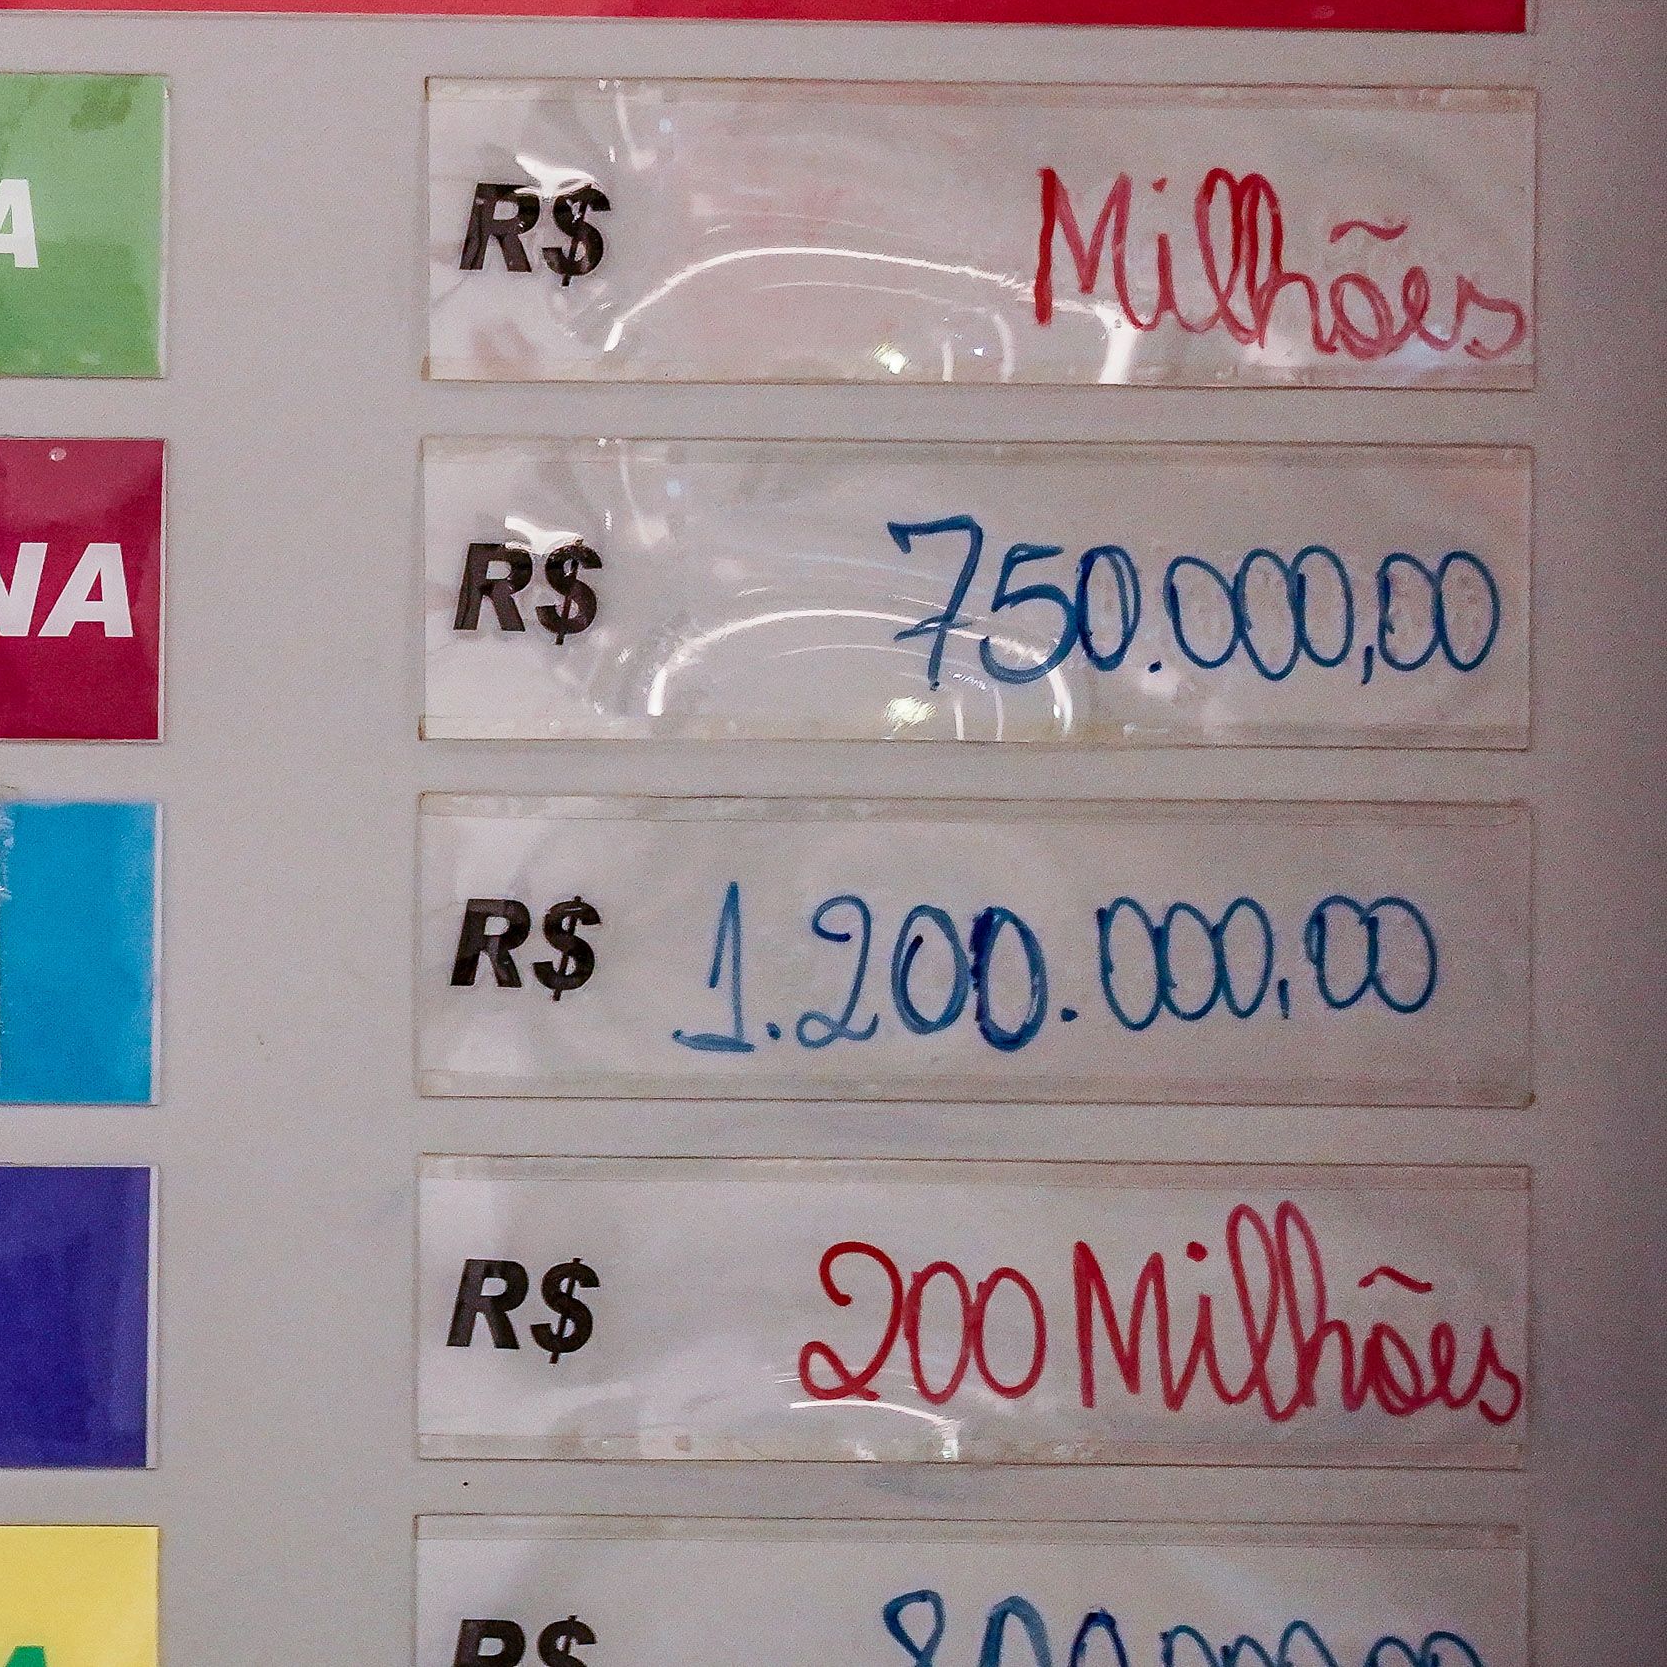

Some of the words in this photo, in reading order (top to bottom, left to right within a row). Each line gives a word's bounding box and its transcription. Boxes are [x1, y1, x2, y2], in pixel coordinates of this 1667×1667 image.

[459, 179, 612, 288] R$
[1032, 165, 1527, 361] Milhões
[452, 540, 604, 646] R$
[886, 513, 1501, 690] 750.000,00
[449, 894, 602, 1003] R$
[671, 880, 1439, 1054] 1.200.000,00
[445, 1256, 601, 1365] R$
[797, 1240, 1048, 1407] 200
[1071, 1199, 1527, 1428] Milhões
